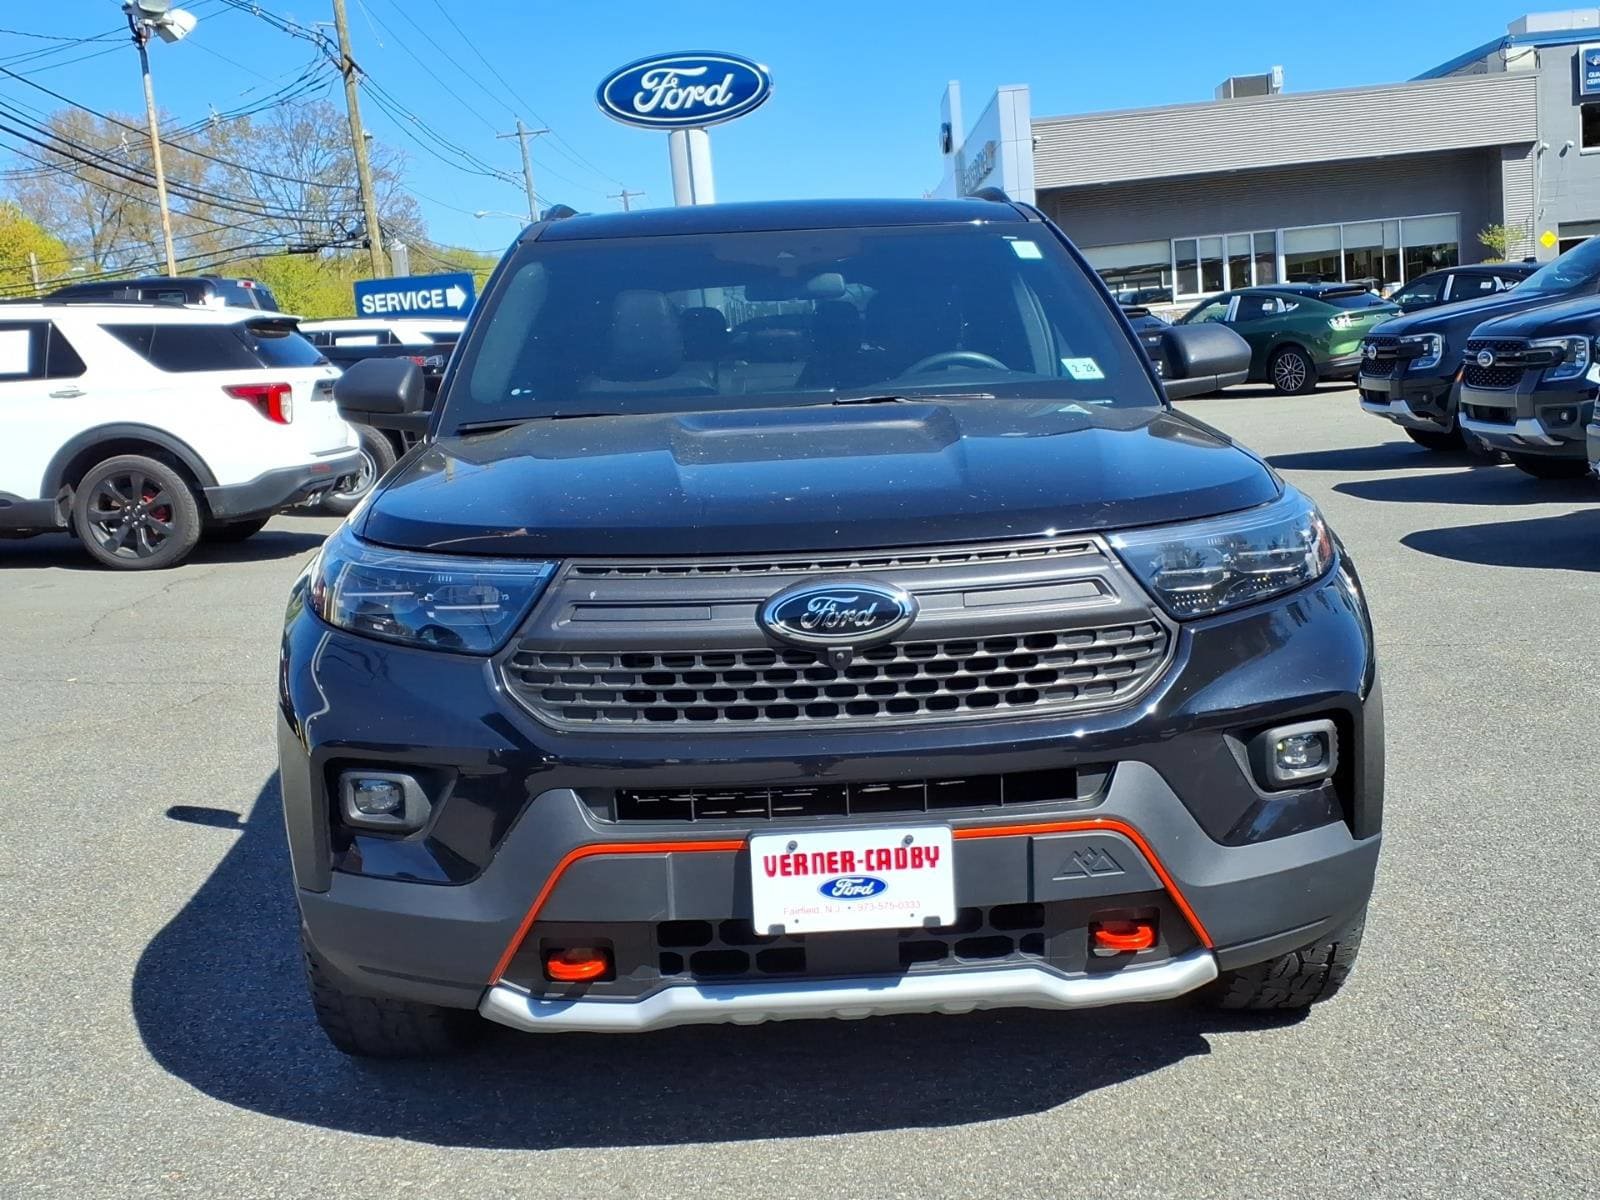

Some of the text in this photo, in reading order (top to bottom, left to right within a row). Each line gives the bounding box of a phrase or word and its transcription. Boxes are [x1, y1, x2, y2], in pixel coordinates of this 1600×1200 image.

[633, 66, 735, 113] Ford
[361, 288, 444, 314] SERVICE
[800, 595, 877, 629] Ford
[763, 845, 941, 878] VERNER-CADBY
[832, 878, 875, 897] Ford
